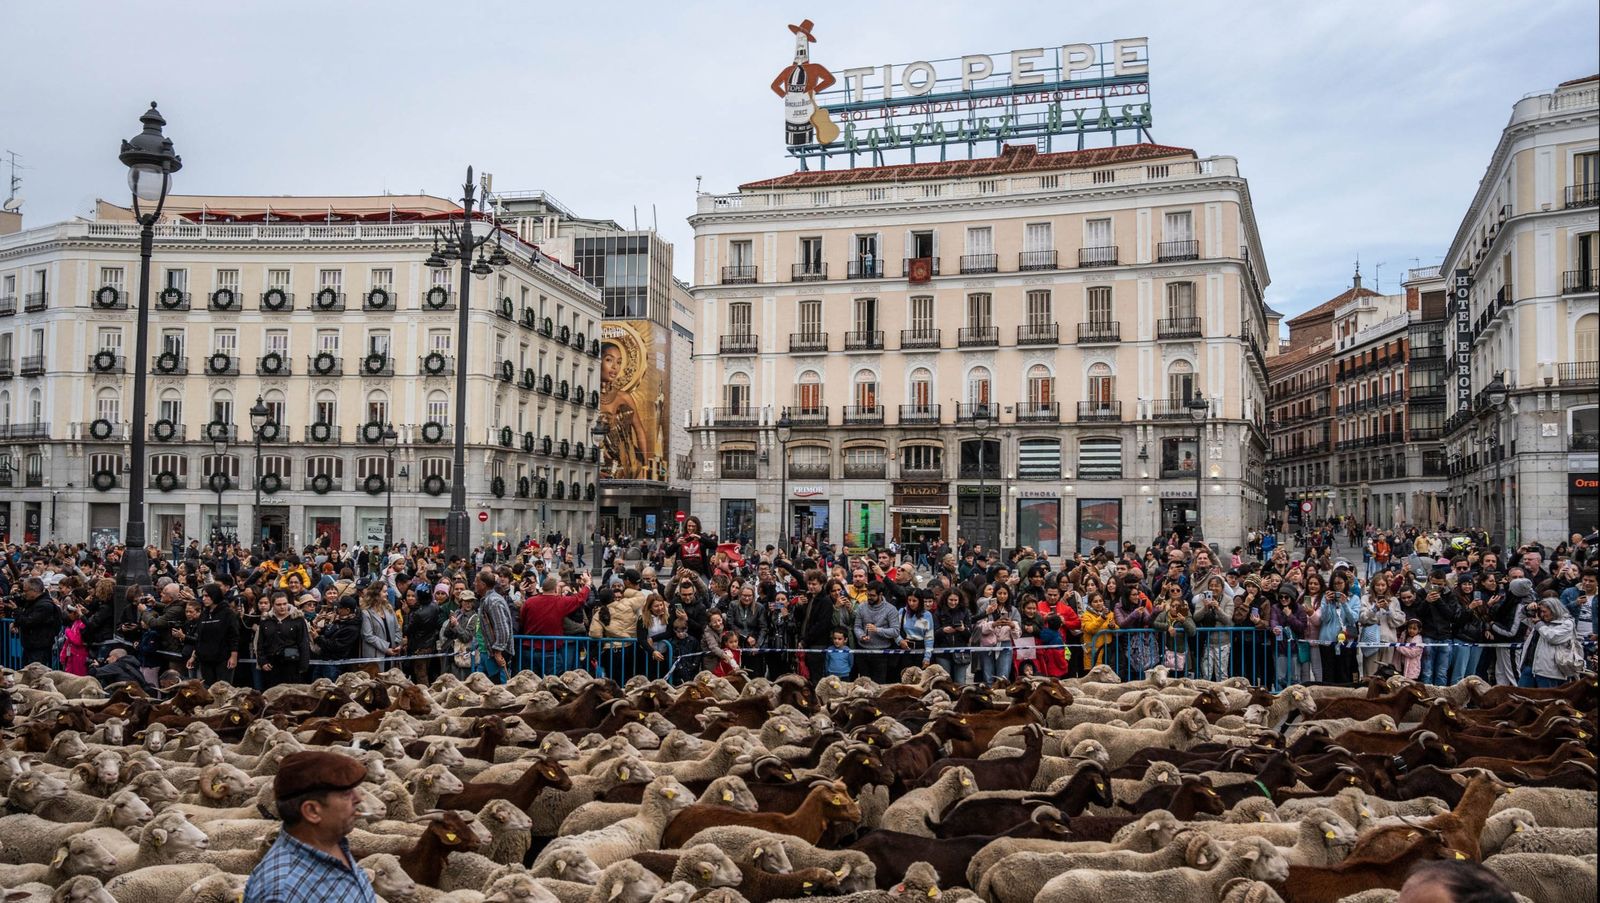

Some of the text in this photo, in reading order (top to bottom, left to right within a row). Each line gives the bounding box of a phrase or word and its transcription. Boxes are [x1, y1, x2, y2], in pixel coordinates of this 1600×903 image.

[844, 37, 1148, 102] TIO PEPE
[840, 83, 1148, 122] SOL DE ANDALUCIA EMBOTELLADO
[844, 114, 1014, 151] GONZALEZ
[1456, 276, 1471, 411] HOTEL EUROPA
[793, 486, 824, 494] PRIMOR
